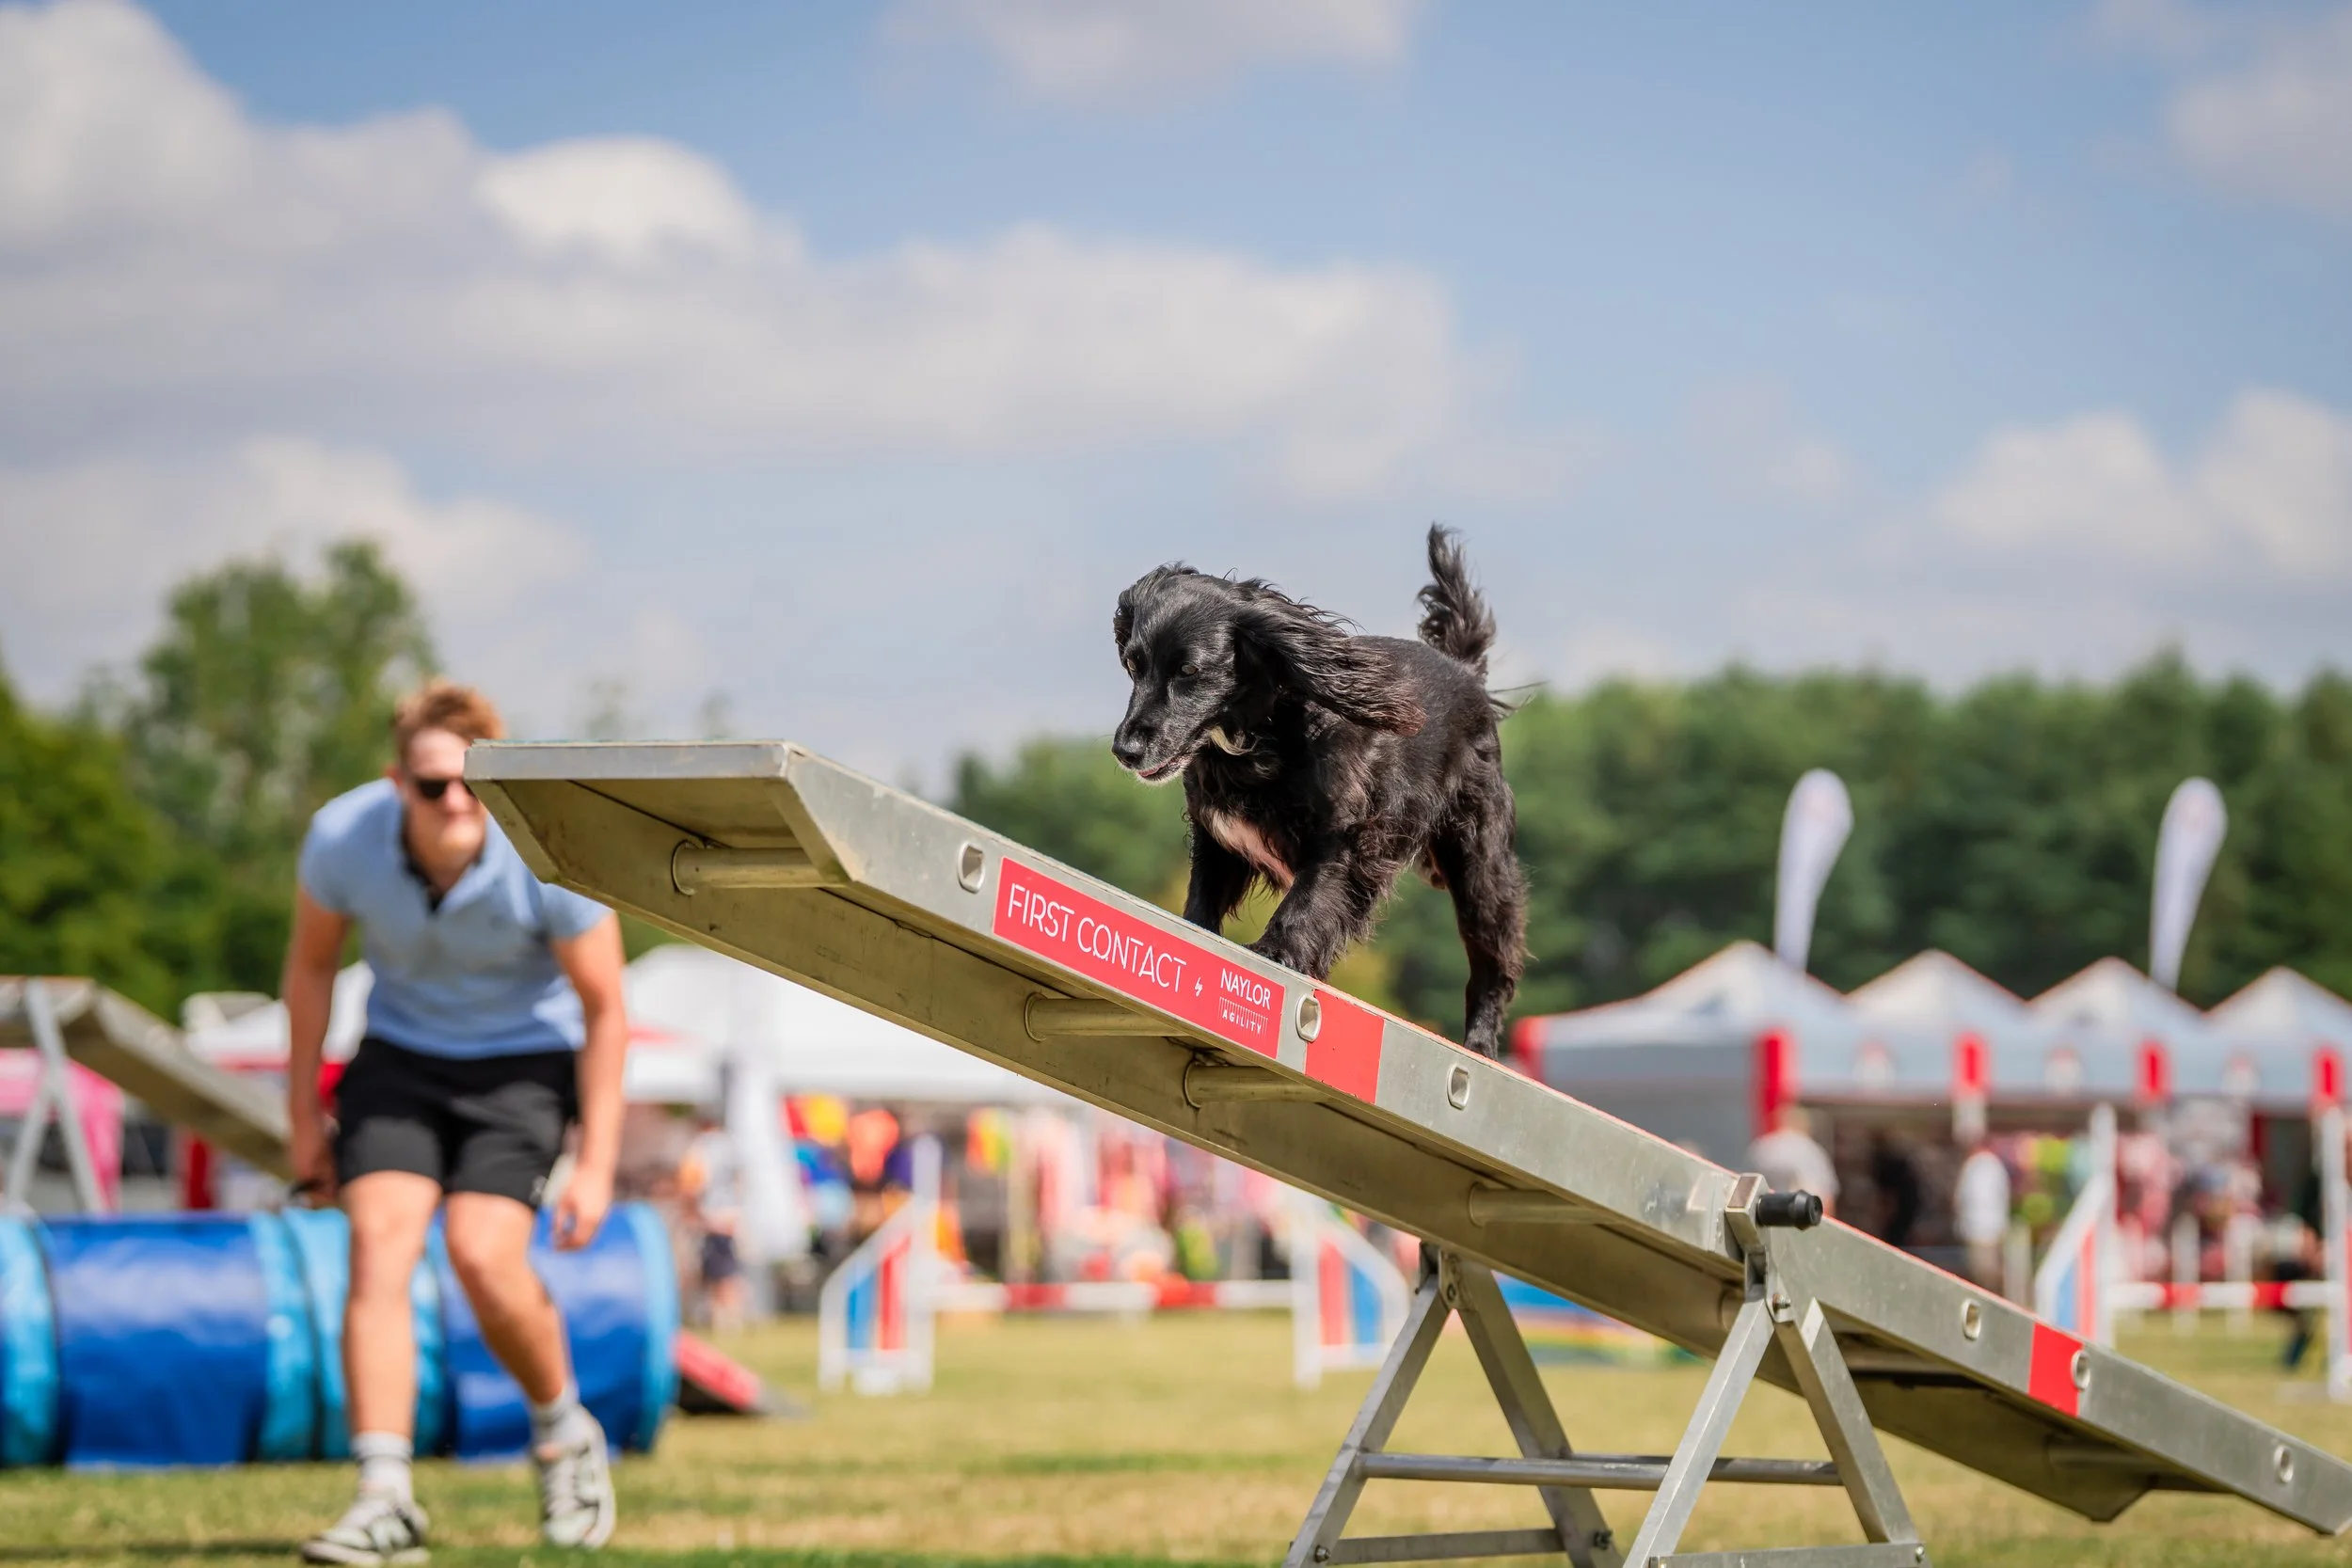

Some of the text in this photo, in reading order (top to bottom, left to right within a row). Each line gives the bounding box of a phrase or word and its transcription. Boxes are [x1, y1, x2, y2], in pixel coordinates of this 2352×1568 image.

[1008, 882, 1075, 942] FIRST
[1077, 916, 1187, 993] CONTACT
[1219, 968, 1272, 1010] NAYLOR
[1221, 1009, 1263, 1035] AGILITY
